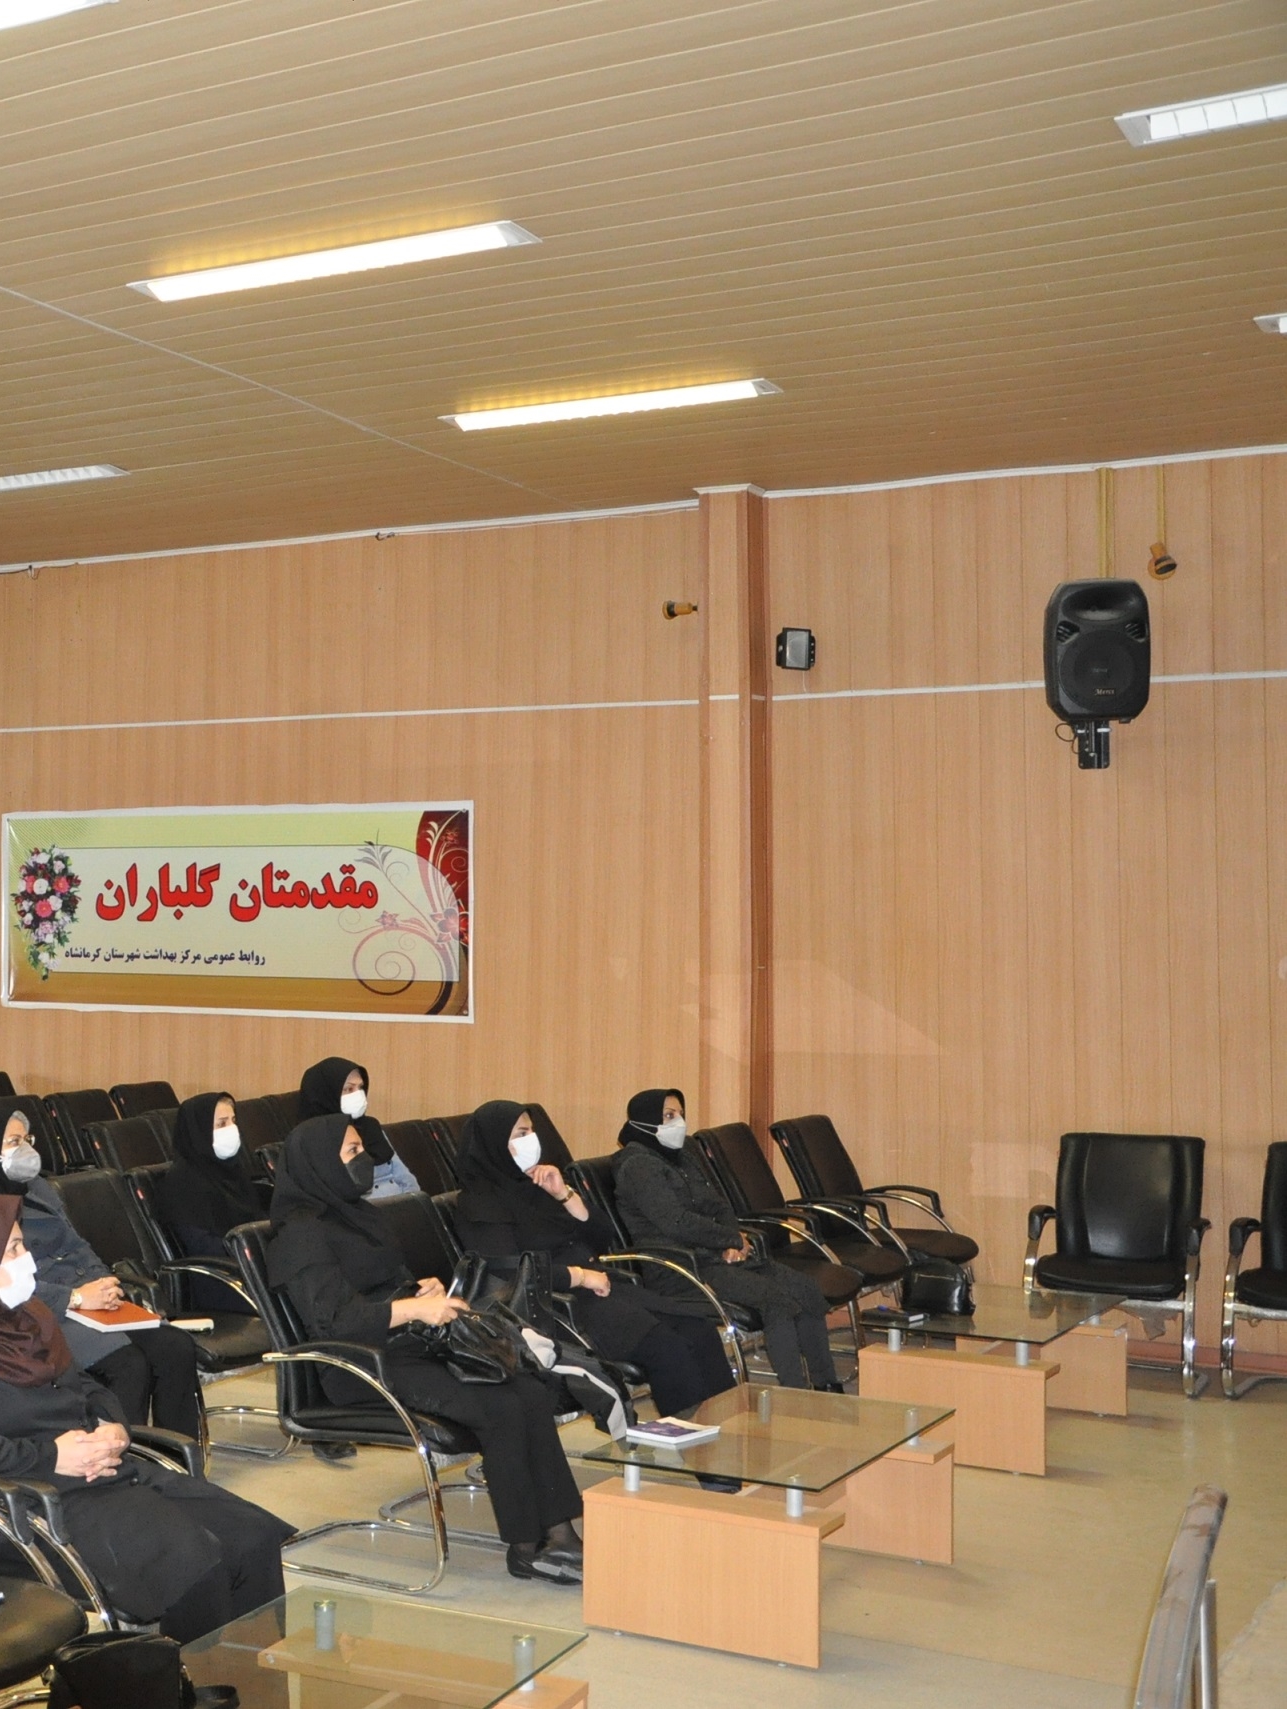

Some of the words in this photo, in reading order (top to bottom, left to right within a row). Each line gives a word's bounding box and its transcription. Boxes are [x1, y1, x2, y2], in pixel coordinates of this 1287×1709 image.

[95, 862, 220, 922] گلباران
[229, 862, 379, 922] مقدمتان
[64, 947, 101, 962] کرمانشاه
[103, 948, 141, 963] شهرستان
[142, 948, 177, 963] بهداشت
[178, 949, 202, 964] مرکز
[204, 951, 235, 965] عمومی
[238, 949, 266, 966] روابط
